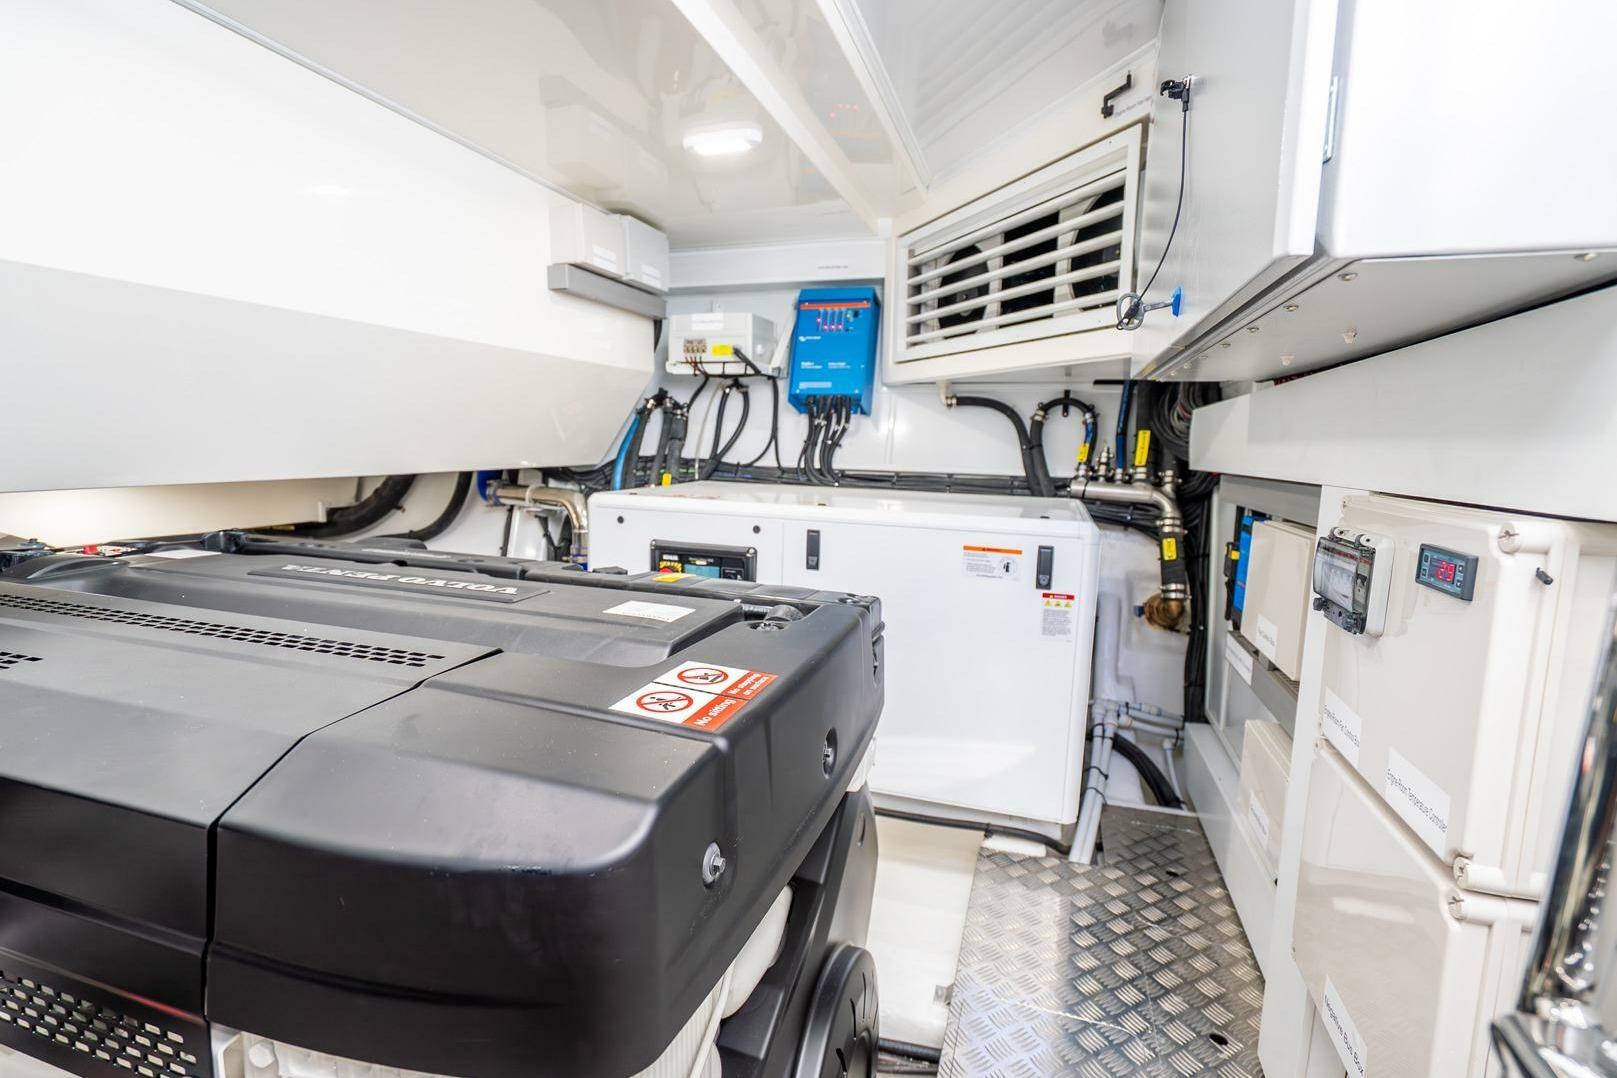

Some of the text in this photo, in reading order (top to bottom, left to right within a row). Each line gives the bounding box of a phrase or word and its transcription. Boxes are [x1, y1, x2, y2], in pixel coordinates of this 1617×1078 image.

[281, 563, 518, 595] VOLVO PENTA
[728, 687, 740, 695] No
[693, 699, 737, 726] No sitting
